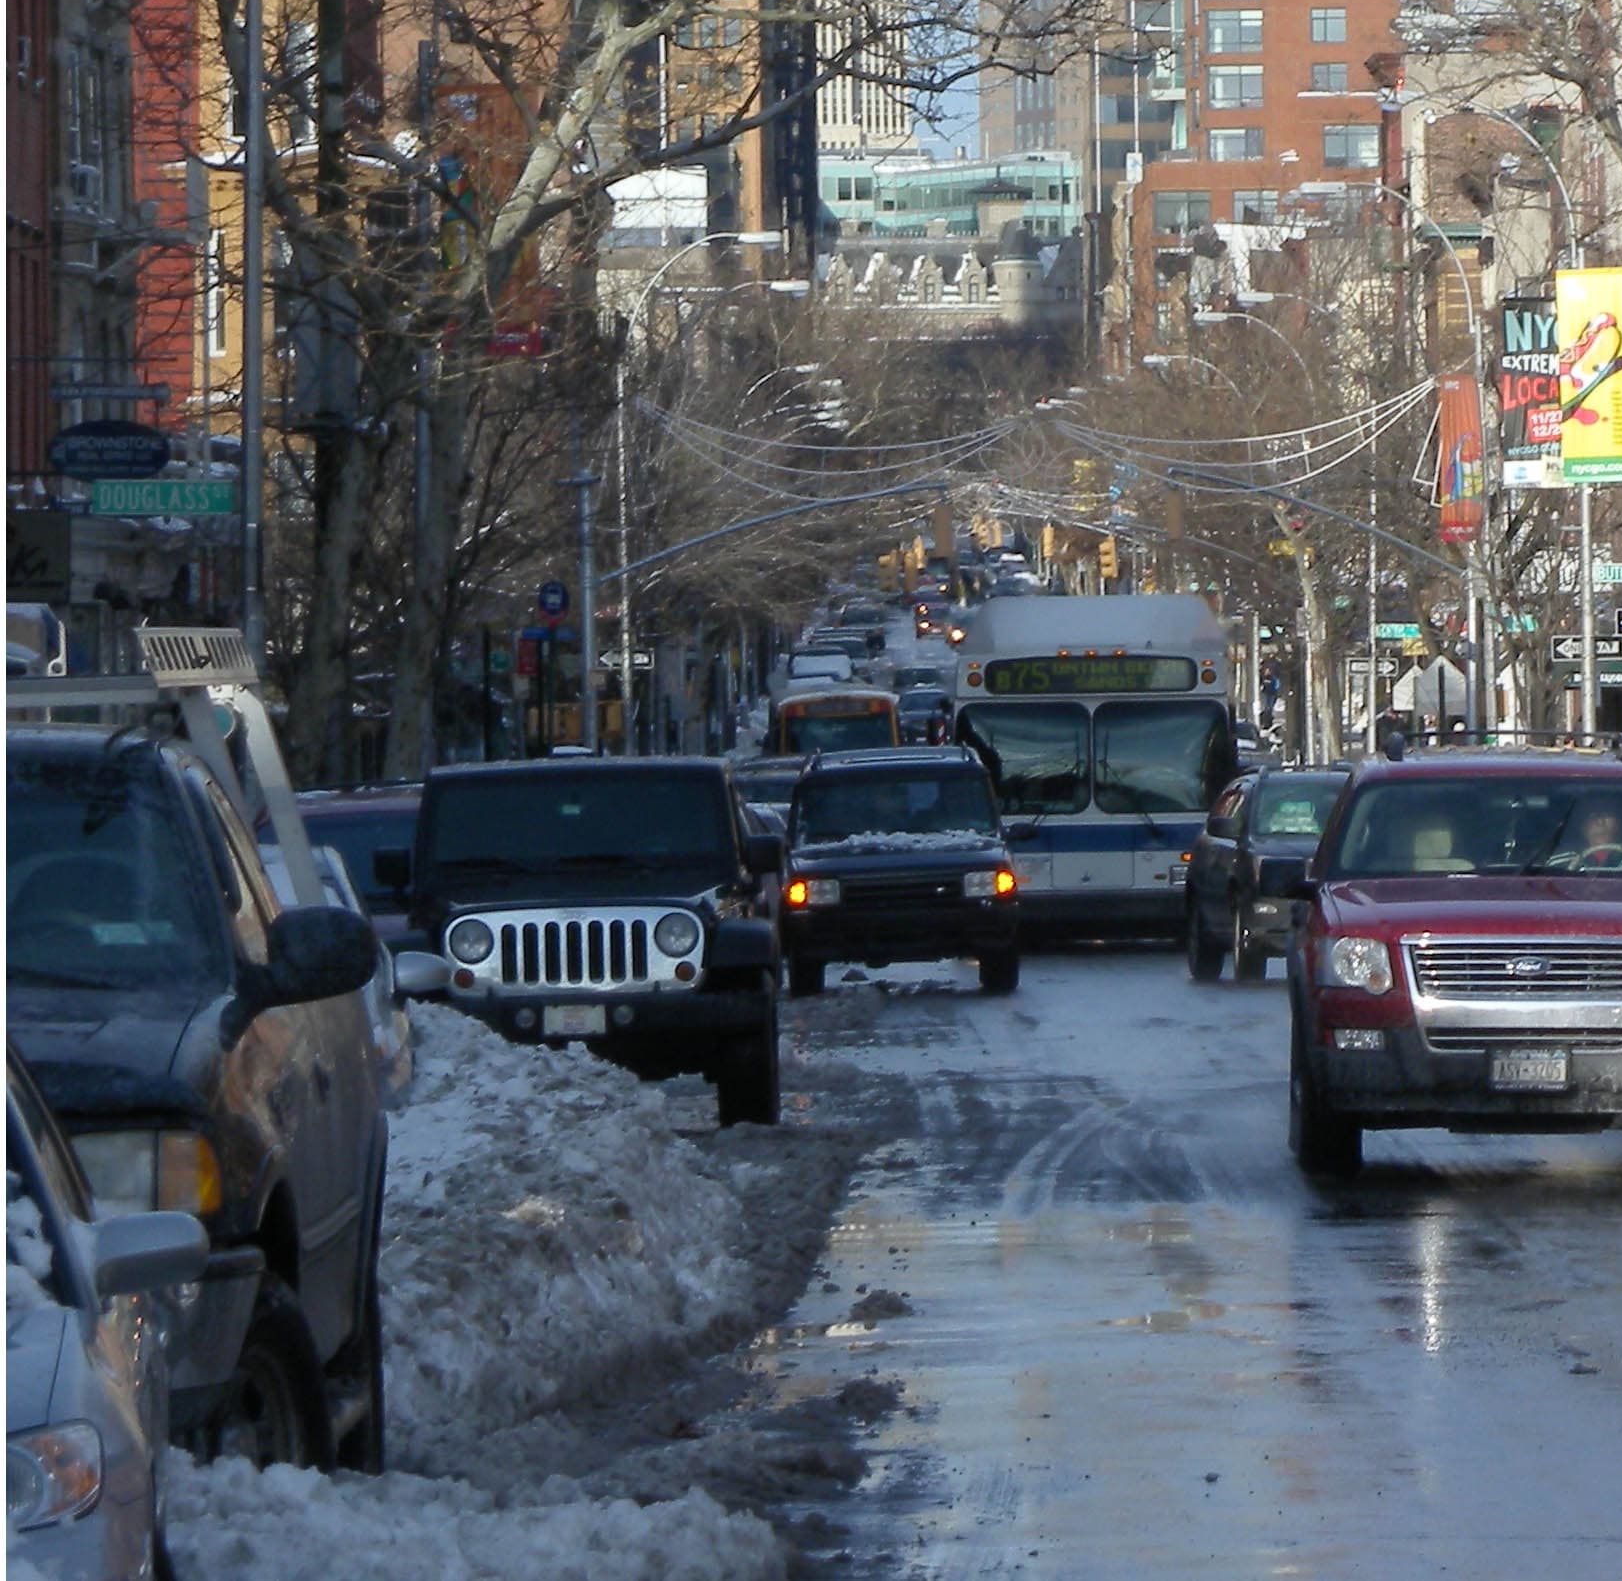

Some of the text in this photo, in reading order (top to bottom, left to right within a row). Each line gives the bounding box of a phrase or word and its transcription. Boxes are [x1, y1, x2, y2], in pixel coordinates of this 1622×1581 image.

[1504, 310, 1559, 352] NY
[1502, 354, 1559, 374] EXTREM
[1503, 375, 1560, 410] LOCA
[101, 484, 210, 511] DOUGLASS
